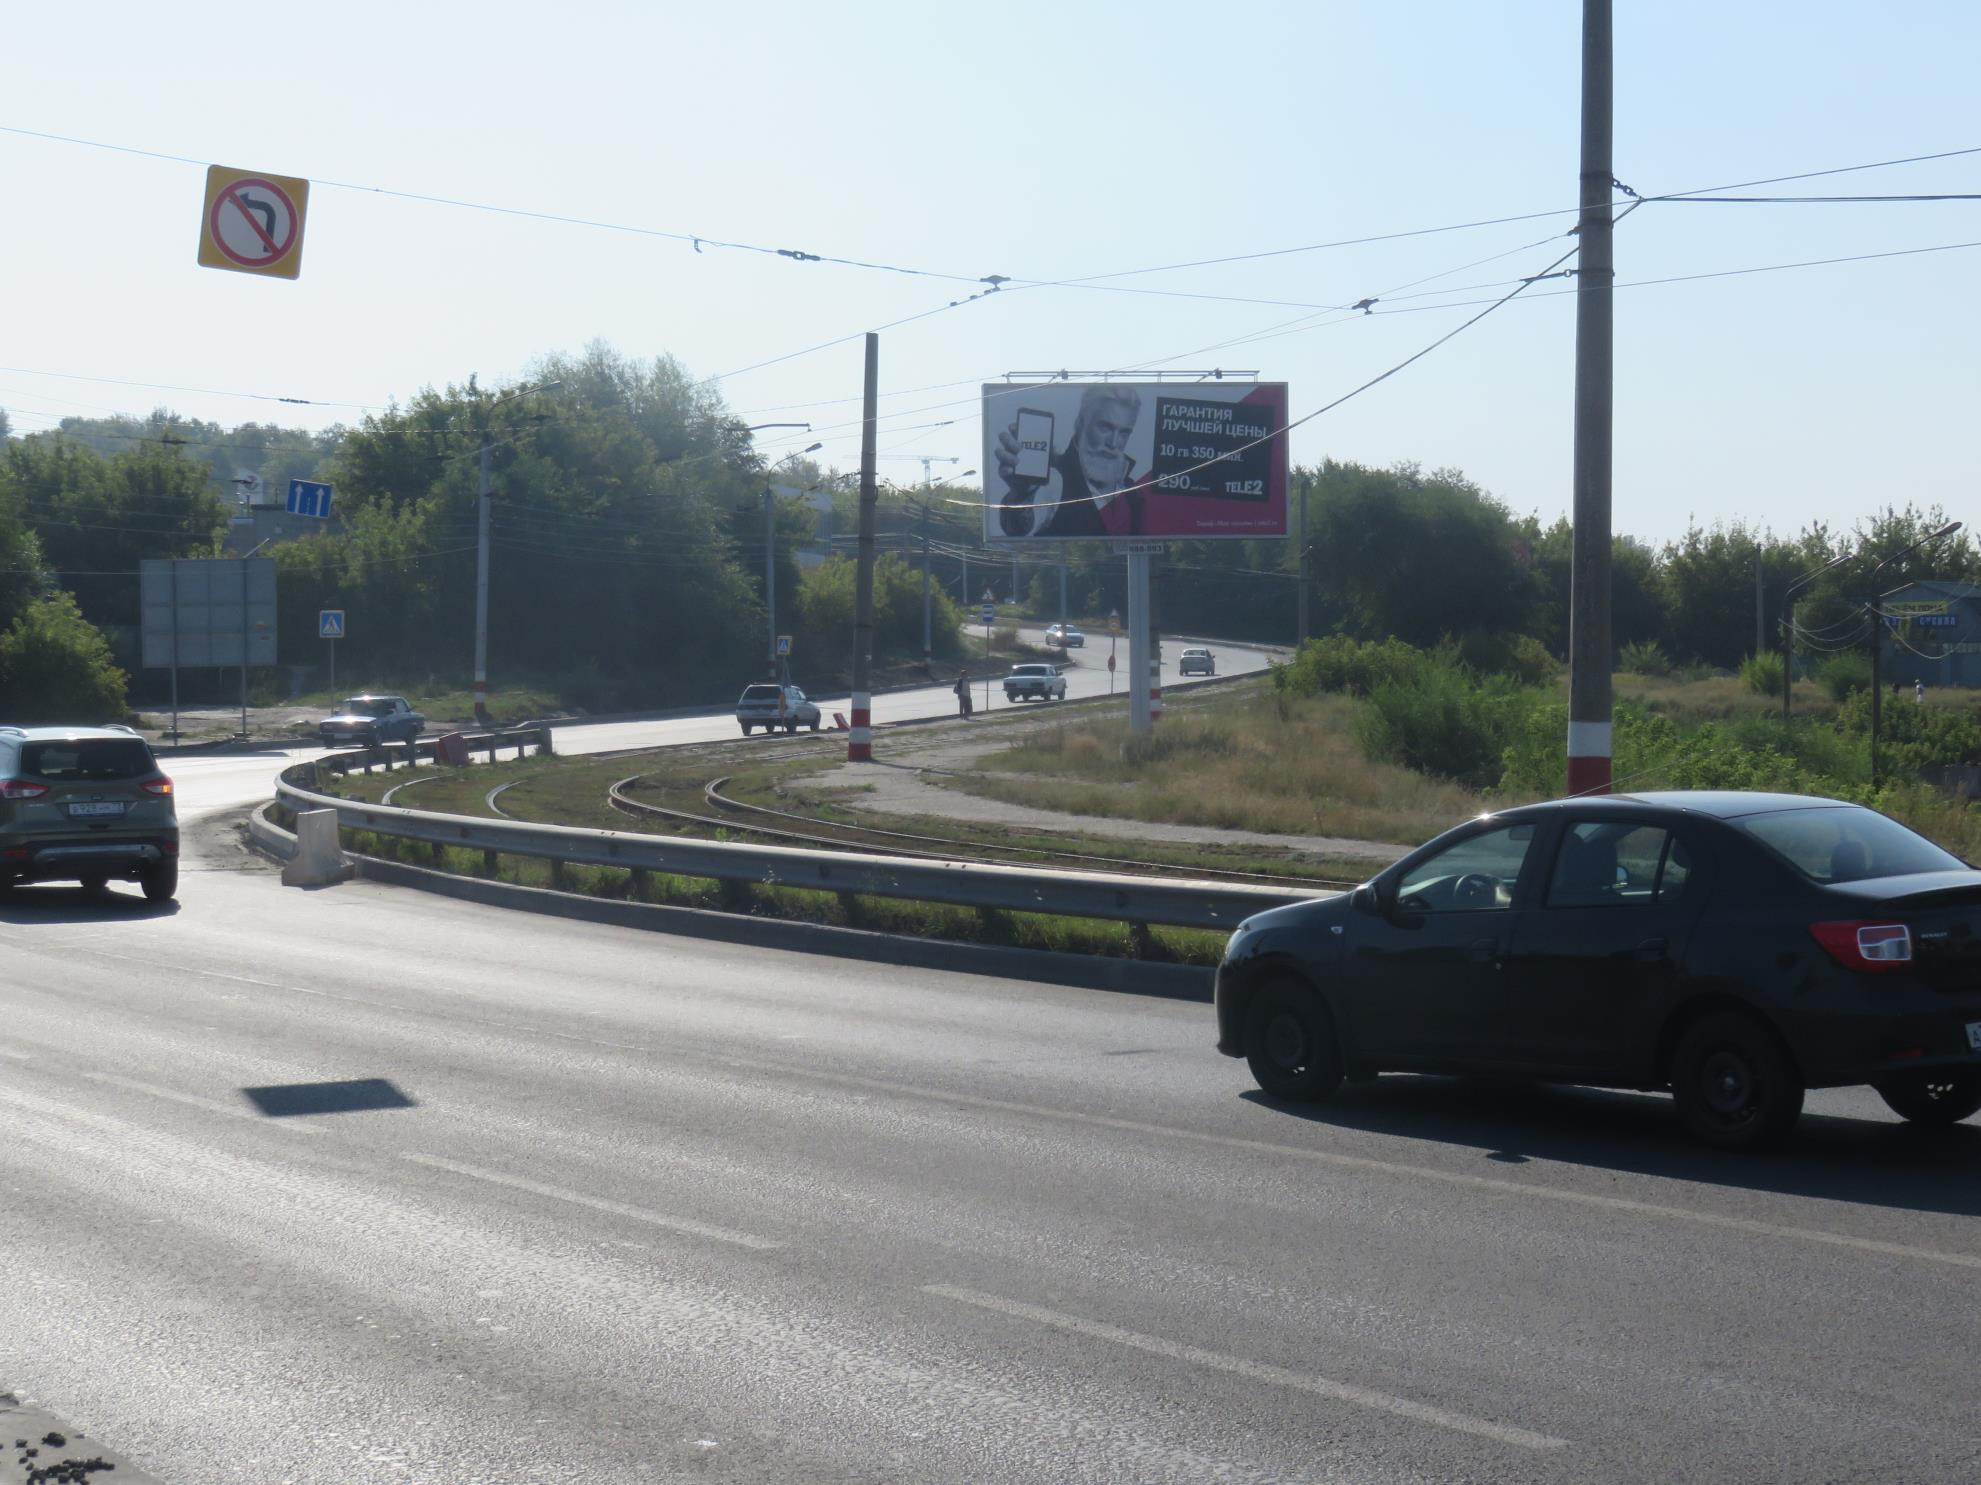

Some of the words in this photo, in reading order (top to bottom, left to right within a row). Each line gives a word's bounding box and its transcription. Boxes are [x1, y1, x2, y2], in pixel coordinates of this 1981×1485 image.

[1162, 404, 1233, 421] ГАРАНТИЯ
[1162, 418, 1222, 435] ЛУЧШЕЙ
[1226, 423, 1267, 438] ЦЕНЫ
[1160, 443, 1175, 457] 10
[1191, 445, 1215, 460] 350
[1158, 474, 1191, 490] 290
[1225, 480, 1263, 495] TELE2
